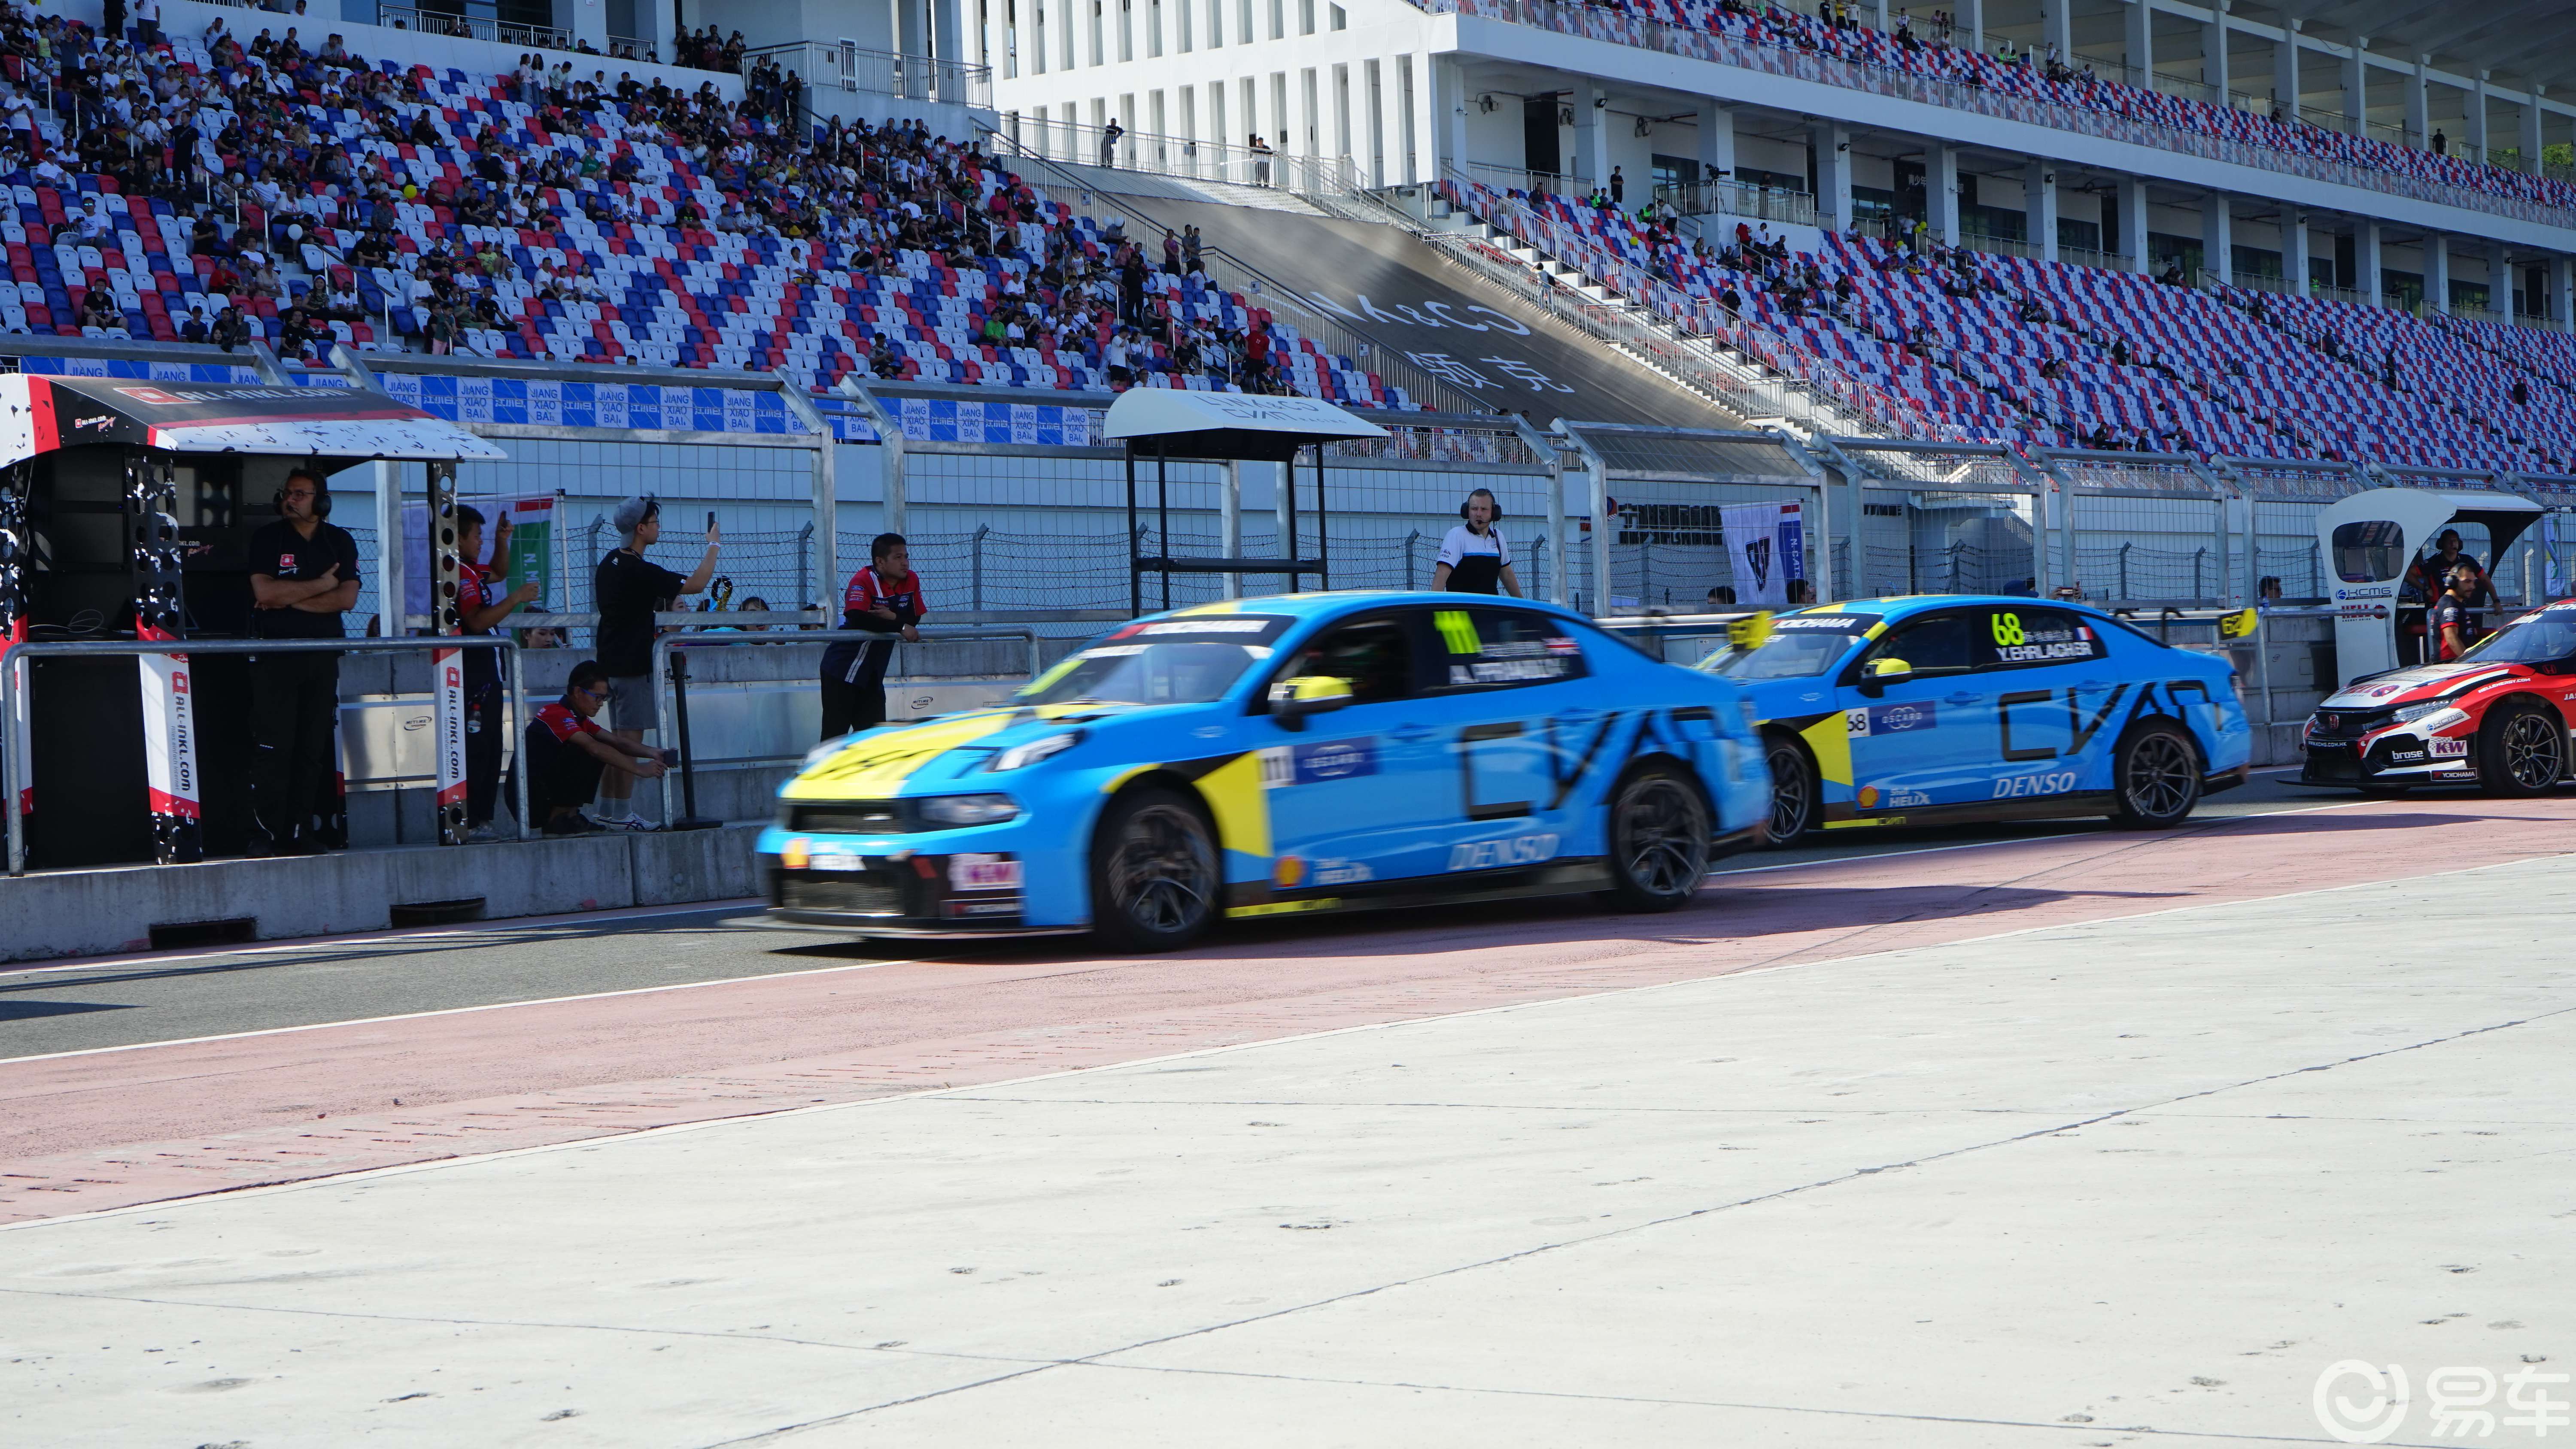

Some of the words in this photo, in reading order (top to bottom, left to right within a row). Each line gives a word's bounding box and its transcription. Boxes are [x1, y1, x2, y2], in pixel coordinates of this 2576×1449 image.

[70, 367, 103, 377] JIANG
[154, 371, 186, 381] JIANG
[313, 378, 342, 386] JIANG
[389, 382, 416, 393] JIANG
[461, 385, 488, 395] JIANG
[531, 388, 558, 399] JIANG
[599, 391, 624, 401] JIANG
[465, 397, 487, 407] XIAO
[664, 394, 689, 404] JIANG
[727, 397, 751, 407] JIANG
[534, 400, 556, 410] XIAO
[601, 403, 622, 412] XIAO
[667, 406, 687, 415] XIAO
[730, 408, 749, 417] XIAO
[905, 406, 926, 415] JIANG
[960, 409, 981, 417] JIANG
[1015, 411, 1033, 420] JIANG
[907, 416, 924, 424] XIAO
[962, 419, 979, 427] XIAO
[1065, 414, 1085, 423] JIANG
[1016, 421, 1032, 430] XIAO
[1067, 424, 1084, 433] XIAO
[1792, 550, 1800, 579] CATS
[2348, 587, 2391, 596] KCMG
[1992, 613, 2025, 646] 68
[2478, 678, 2531, 694] HELLENERGY.COM
[1847, 713, 1865, 732] 68
[2434, 712, 2463, 727] KCMG
[449, 690, 459, 779] ALL-INKL.COM
[175, 696, 191, 791] ALL-INKL.COM
[2436, 741, 2465, 754] KW
[2392, 750, 2424, 760] brose
[1993, 772, 2077, 798] DENSO
[1889, 791, 1931, 807] HELIX
